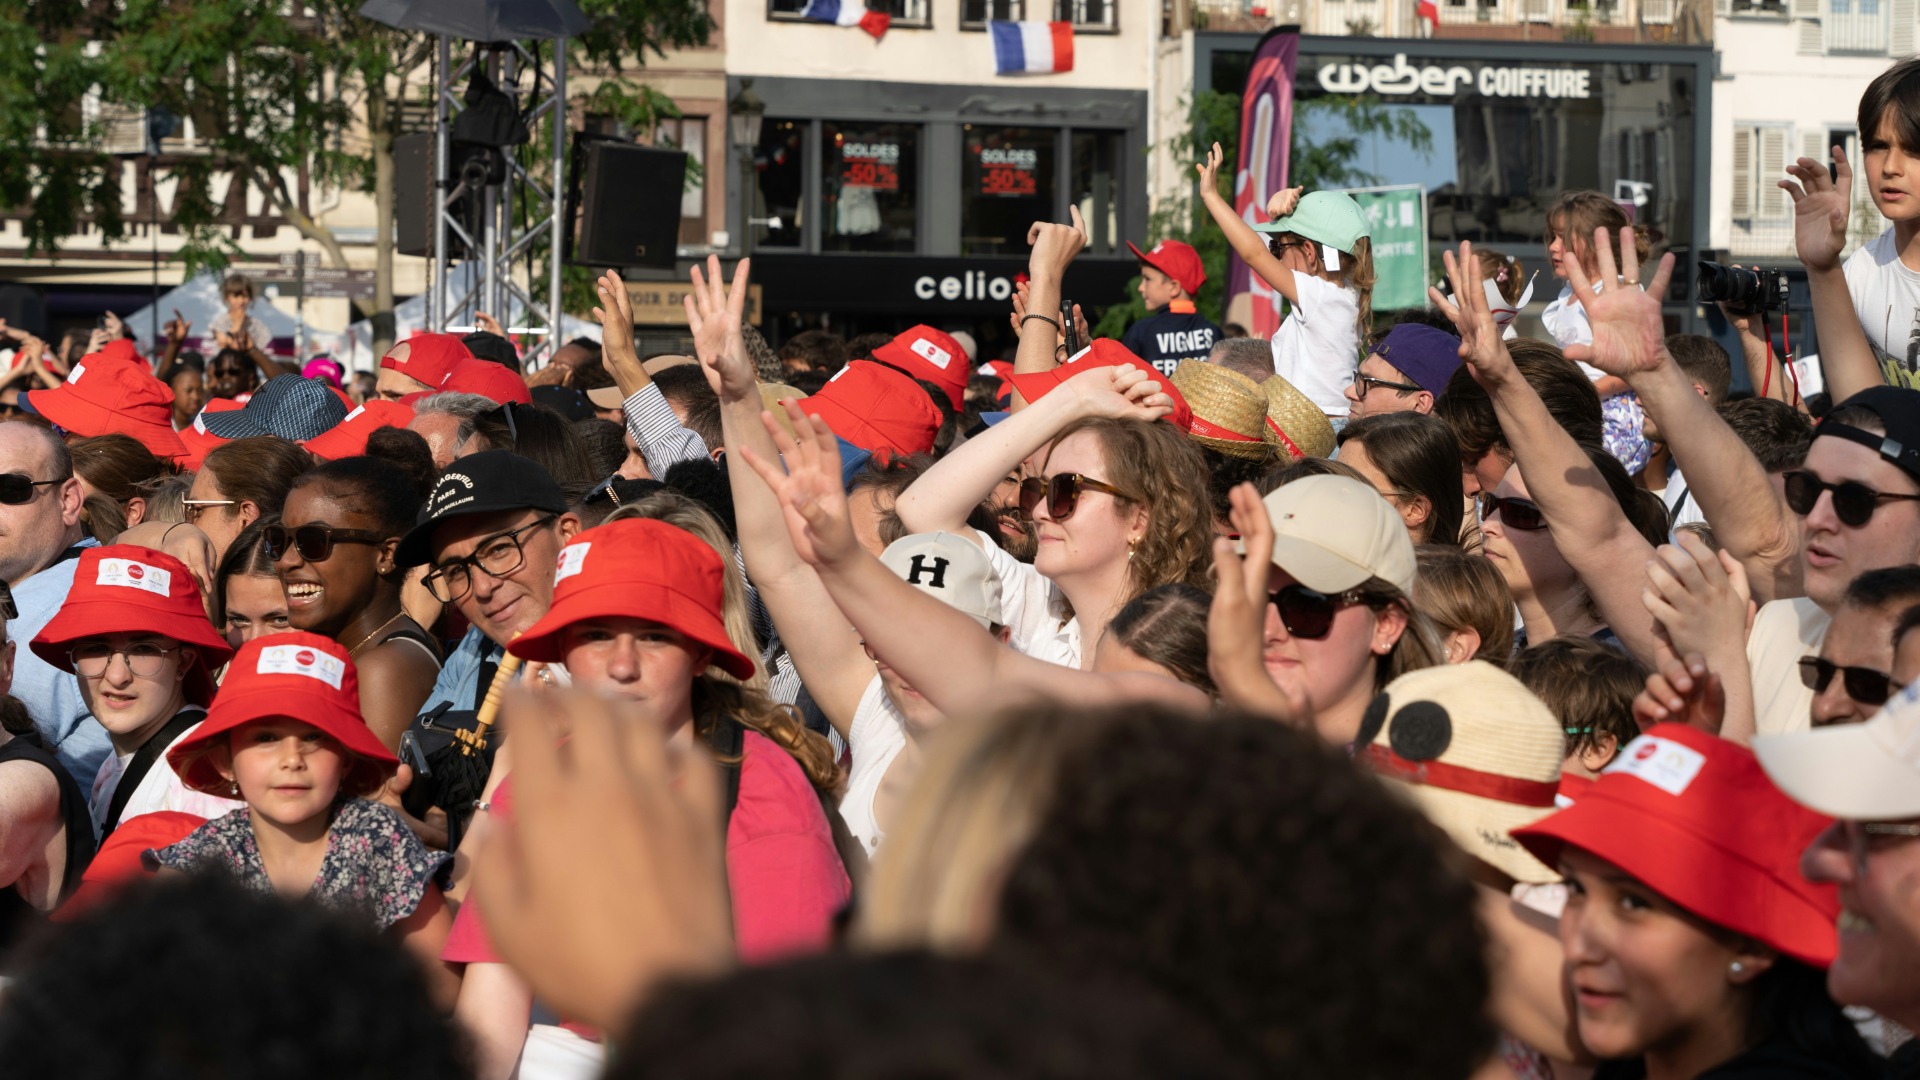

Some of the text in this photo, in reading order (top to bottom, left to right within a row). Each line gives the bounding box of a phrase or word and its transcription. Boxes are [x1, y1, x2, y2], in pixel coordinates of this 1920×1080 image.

[1318, 53, 1591, 98] weber COIFFURE
[842, 143, 900, 158] SOLDES
[981, 149, 1037, 164] SOLDES
[1373, 242, 1416, 258] ORTIE
[915, 270, 1012, 301] celio
[1156, 328, 1214, 354] VIGNES
[436, 473, 473, 488] LAGERFELD
[437, 488, 456, 503] PARIS
[907, 554, 950, 588] H
